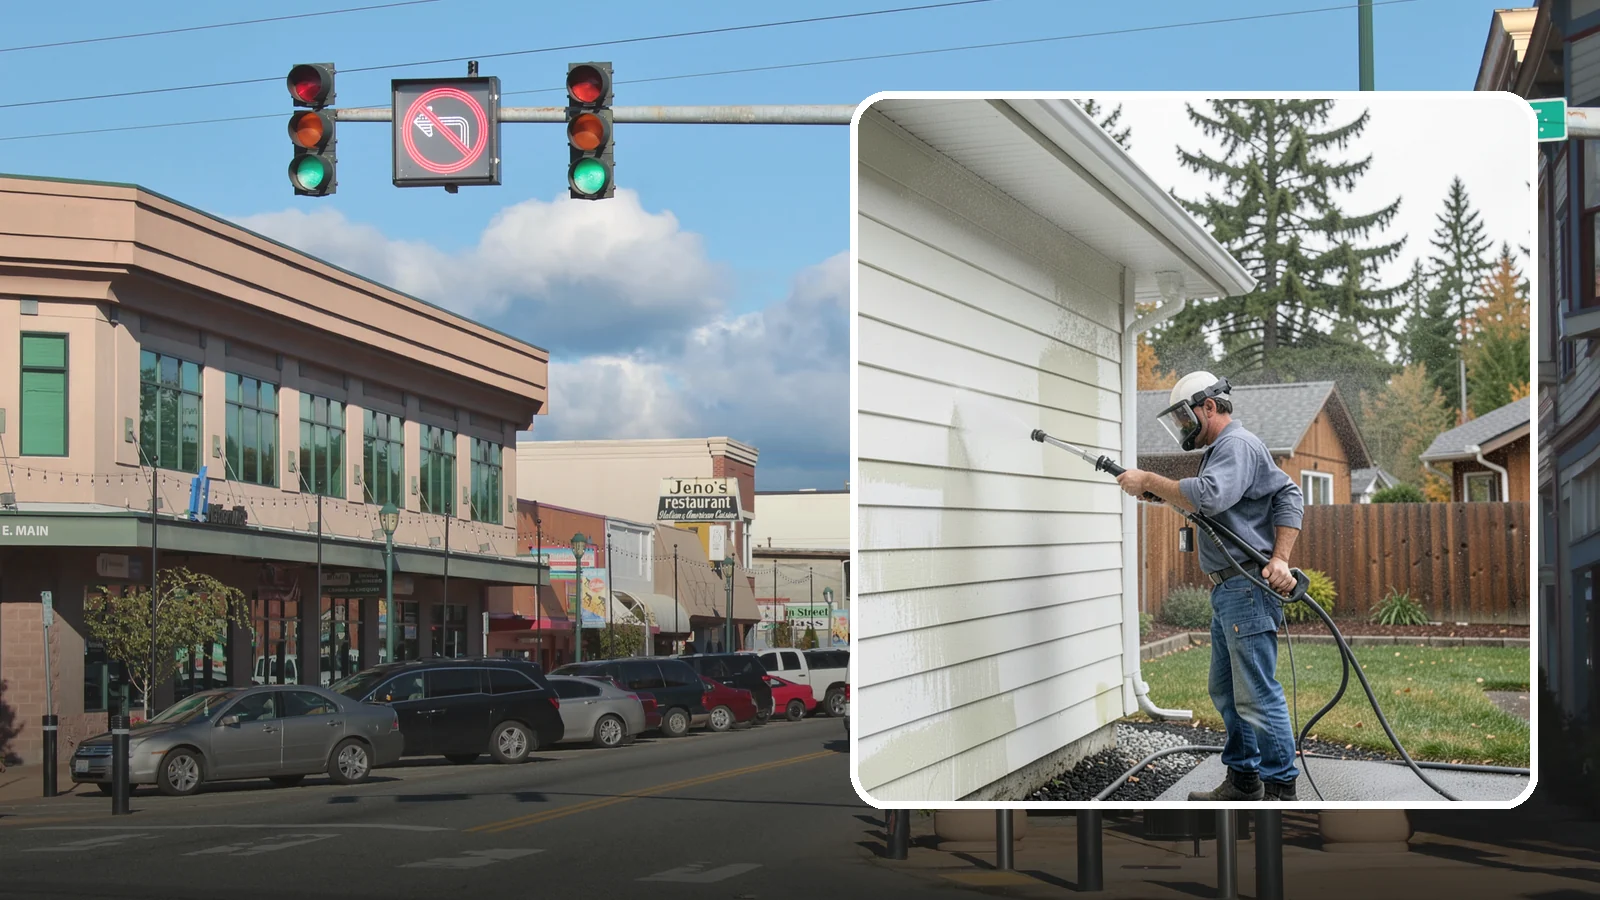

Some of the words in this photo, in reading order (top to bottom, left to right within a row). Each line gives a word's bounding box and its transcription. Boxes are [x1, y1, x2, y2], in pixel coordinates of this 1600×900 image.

[669, 480, 728, 494] Jeno's
[665, 496, 731, 509] restaurant
[658, 510, 682, 519] Italian
[686, 510, 714, 519] American
[715, 510, 738, 518] Cuisine
[2, 525, 13, 536] E.
[16, 525, 49, 536] MAIN
[797, 607, 828, 617] Street
[791, 619, 824, 627] lass
